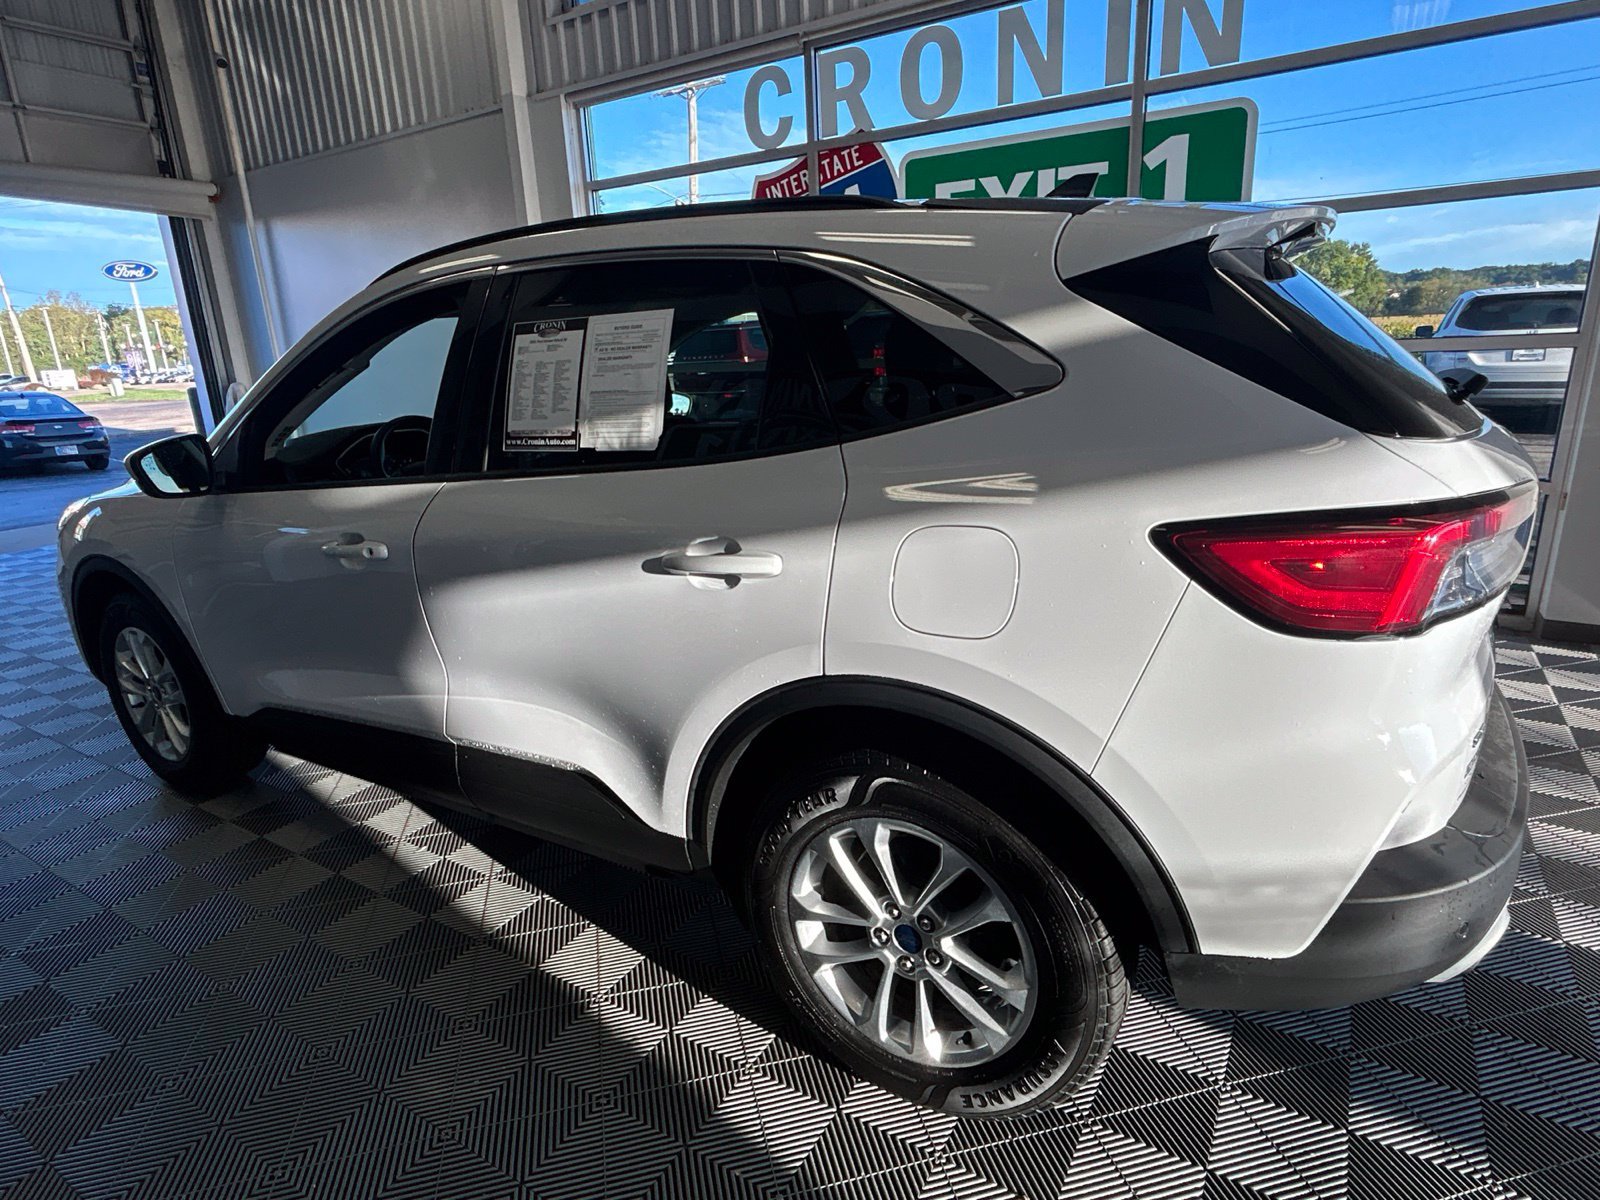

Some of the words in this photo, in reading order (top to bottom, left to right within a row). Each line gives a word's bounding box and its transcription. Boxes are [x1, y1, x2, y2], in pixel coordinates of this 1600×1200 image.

[744, 0, 1244, 150] CRONIN
[765, 145, 864, 198] INTERTATE
[113, 263, 145, 278] Ford
[533, 320, 568, 333] CRONIN
[506, 438, 576, 446] www.CroninAuto.com
